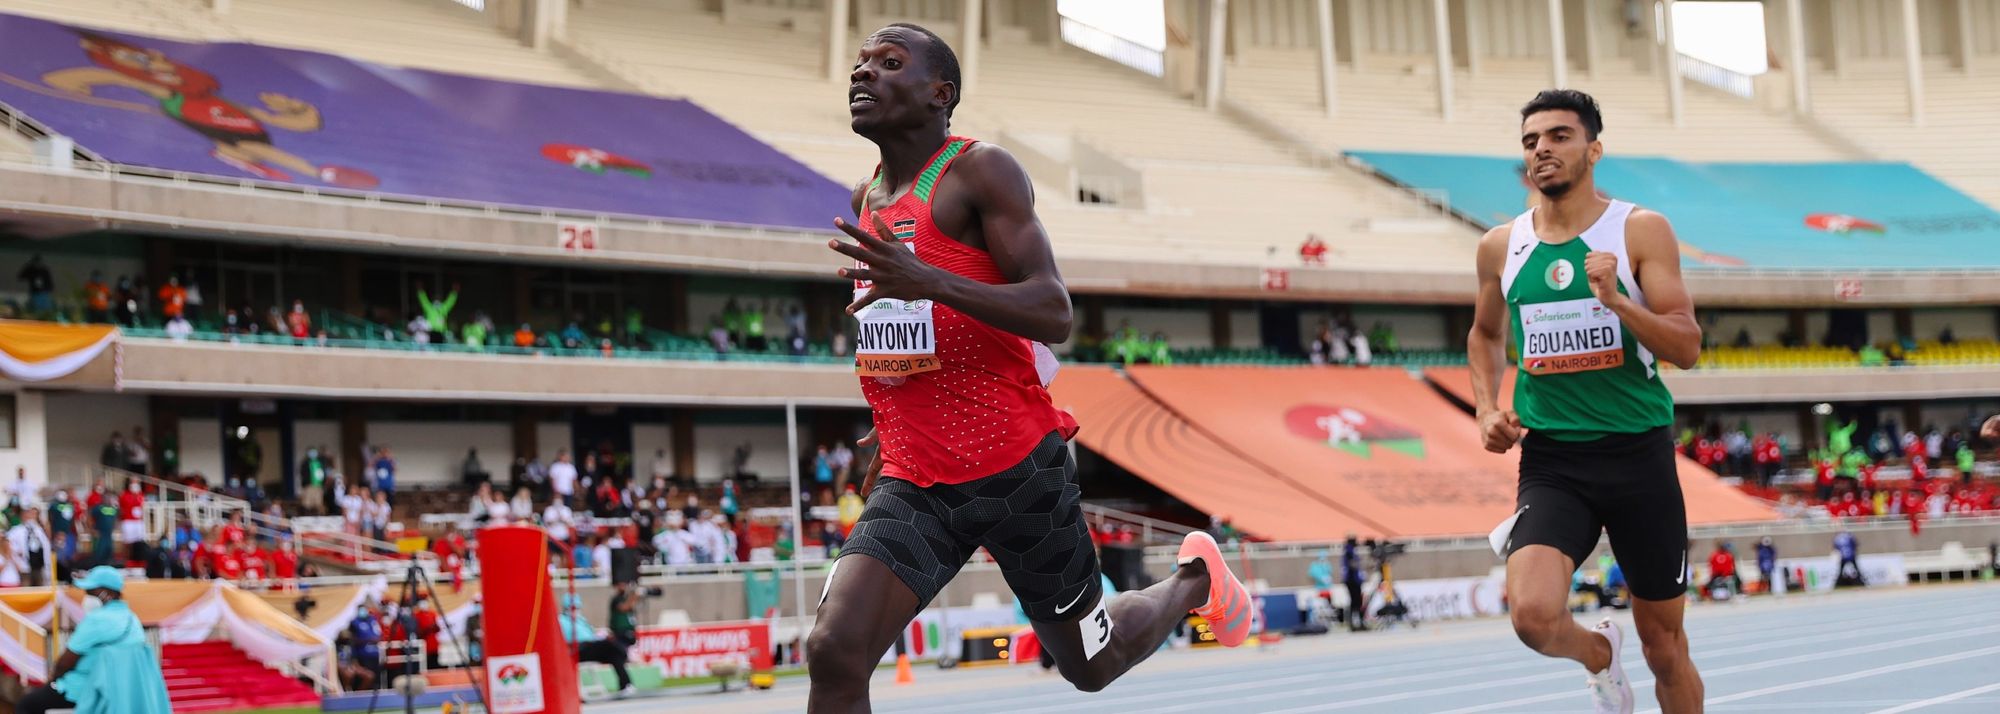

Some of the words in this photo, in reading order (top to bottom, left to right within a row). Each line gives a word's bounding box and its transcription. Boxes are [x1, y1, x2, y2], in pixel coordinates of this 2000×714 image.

[1533, 310, 1581, 323] Safaricom
[857, 322, 928, 350] ANYONYI
[1529, 326, 1615, 355] GOUANED
[864, 359, 913, 372] NAIROBI
[915, 358, 933, 368] 21
[1551, 356, 1601, 370] NAIROBI
[1604, 354, 1619, 365] 21
[1094, 608, 1109, 644] 3
